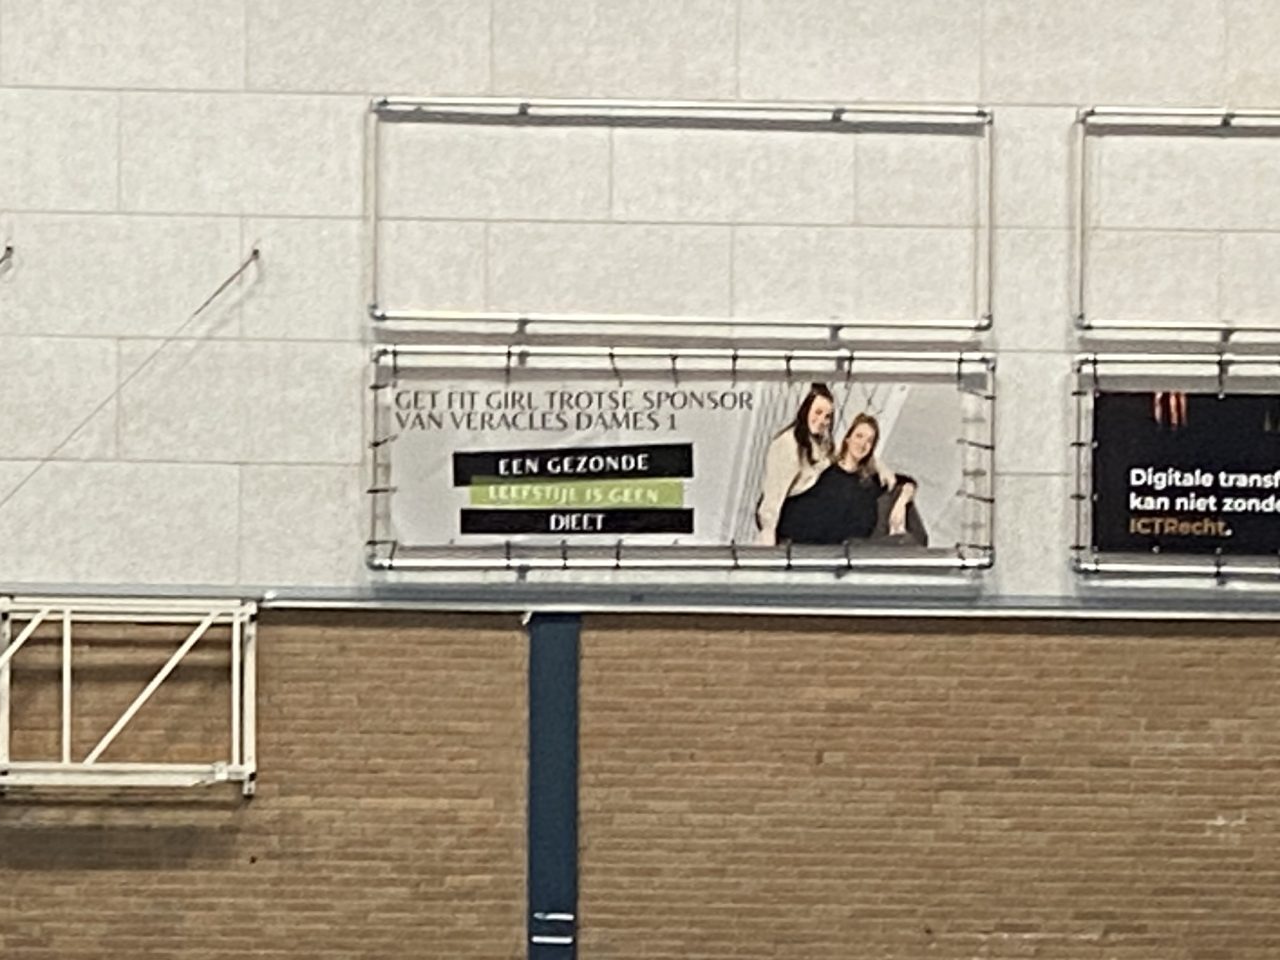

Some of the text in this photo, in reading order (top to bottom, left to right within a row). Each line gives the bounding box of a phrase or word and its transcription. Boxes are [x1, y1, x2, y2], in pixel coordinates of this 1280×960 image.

[395, 390, 753, 411] GET FIT GIRL TROTSE SPONSOR
[395, 411, 677, 432] VAN VERACLES DAMES 1
[498, 453, 650, 475] EEN GEZONDE
[1130, 466, 1214, 490] Digitale
[585, 487, 603, 502] IS
[608, 487, 659, 504] GEEN
[1129, 491, 1170, 511] kan
[1175, 491, 1218, 511] niet
[549, 513, 606, 531] DIEET
[1130, 518, 1232, 536] ICTRecht.
